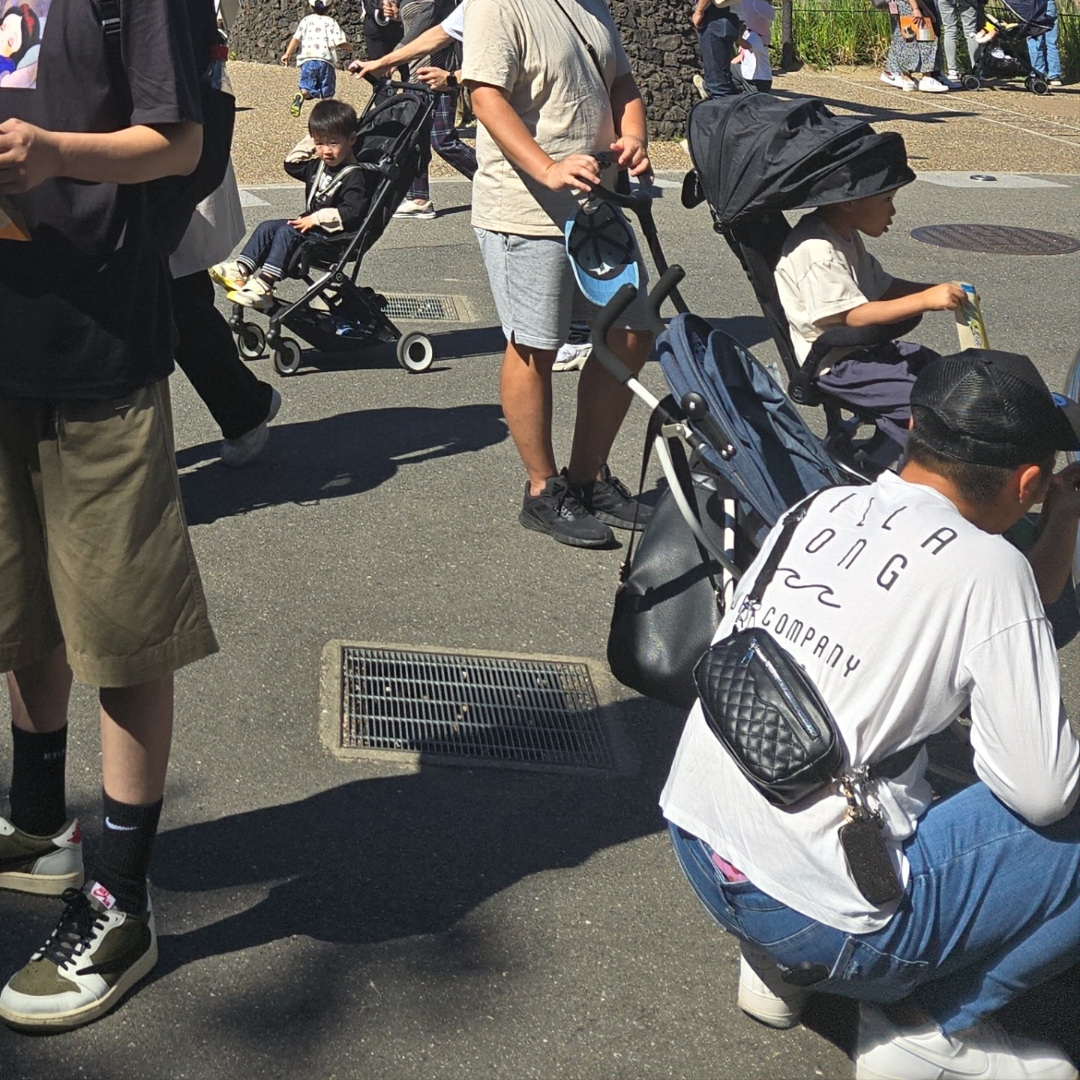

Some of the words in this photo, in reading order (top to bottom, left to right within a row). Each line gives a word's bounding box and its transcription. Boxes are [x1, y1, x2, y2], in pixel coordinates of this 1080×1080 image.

[829, 492, 958, 556] ILLA
[805, 528, 908, 591] ONG
[761, 606, 861, 678] COMPANY
